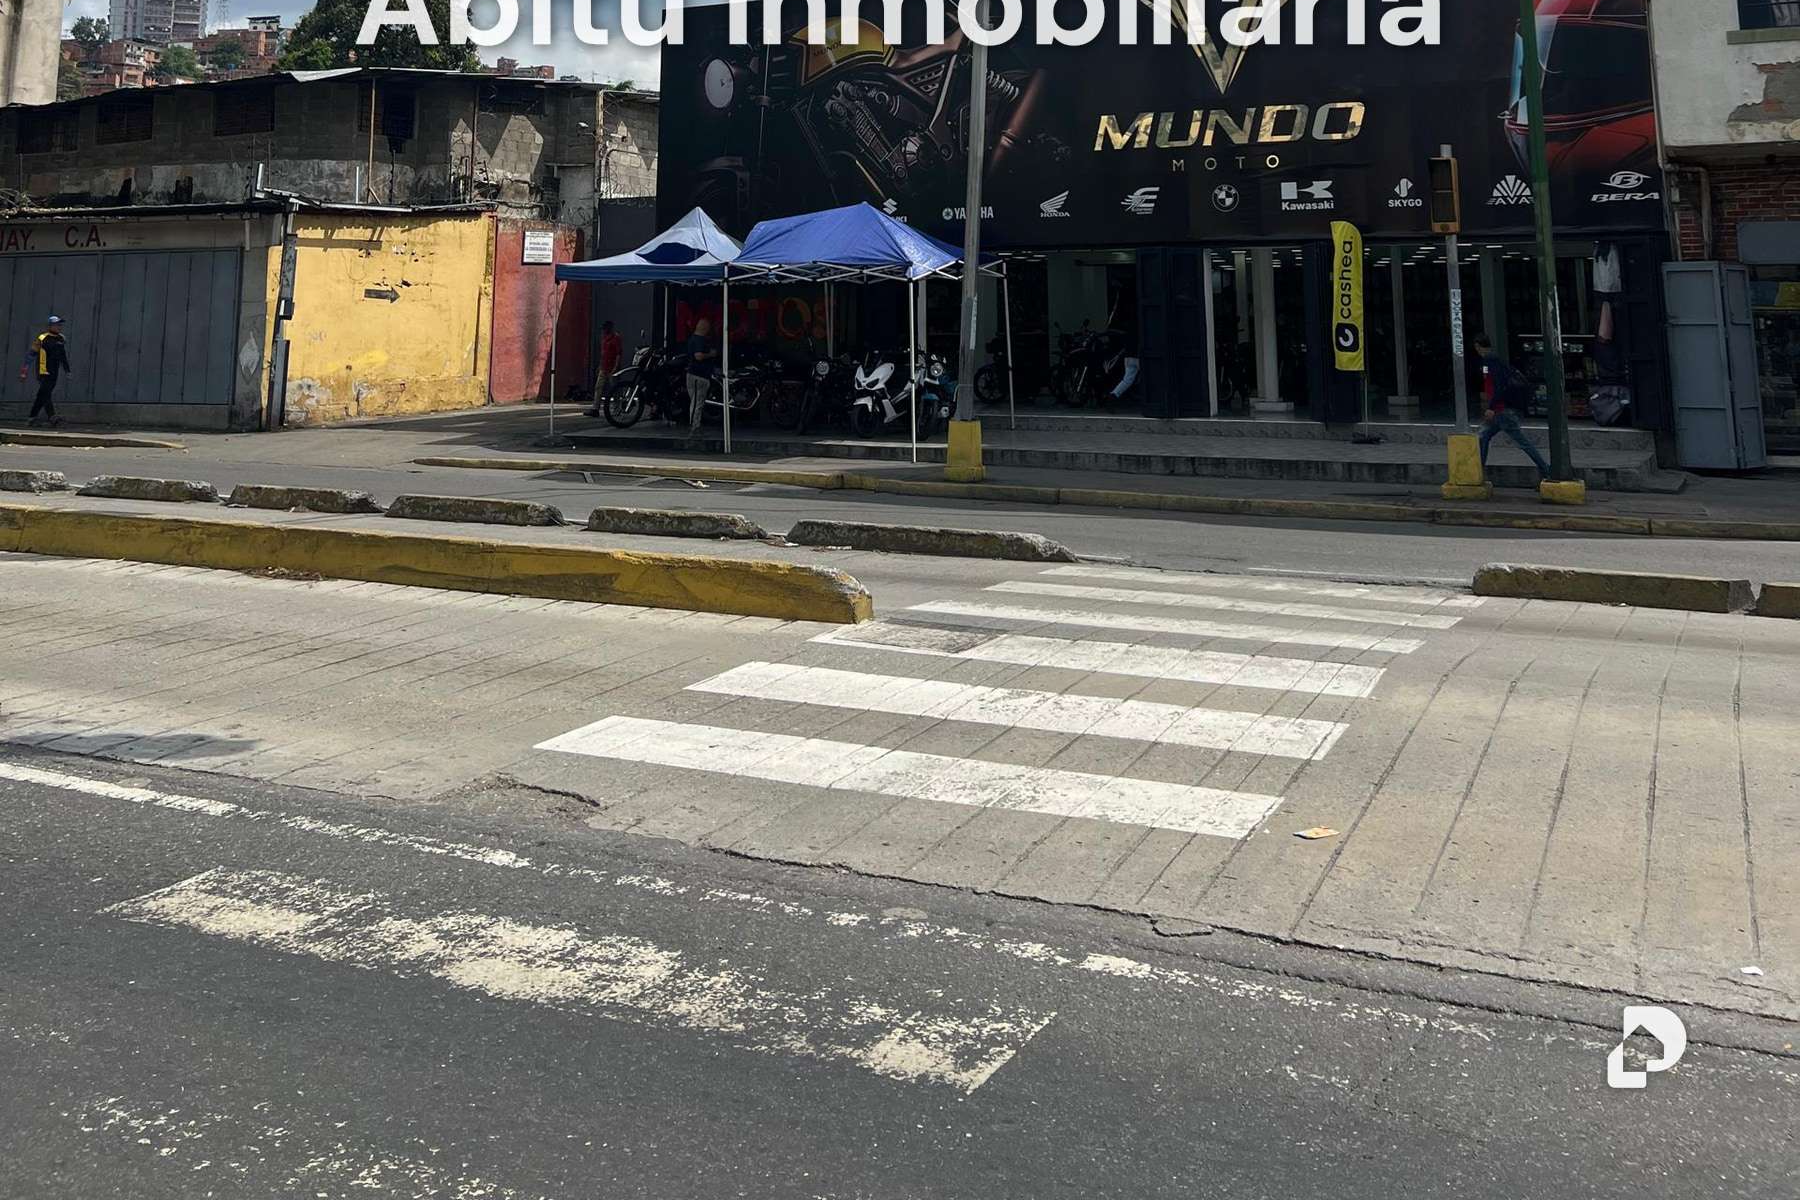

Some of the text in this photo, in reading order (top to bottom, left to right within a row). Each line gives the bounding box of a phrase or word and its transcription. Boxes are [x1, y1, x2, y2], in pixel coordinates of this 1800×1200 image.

[1094, 102, 1365, 150] MUNDO
[1172, 155, 1279, 172] MOTO
[1388, 199, 1422, 207] SKYGO
[1494, 197, 1531, 206] AVA
[1592, 193, 1660, 202] BERA
[1281, 201, 1334, 210] Kawasaki
[954, 206, 994, 220] YAHA
[0, 228, 35, 252] AY.
[65, 224, 106, 248] C.A.
